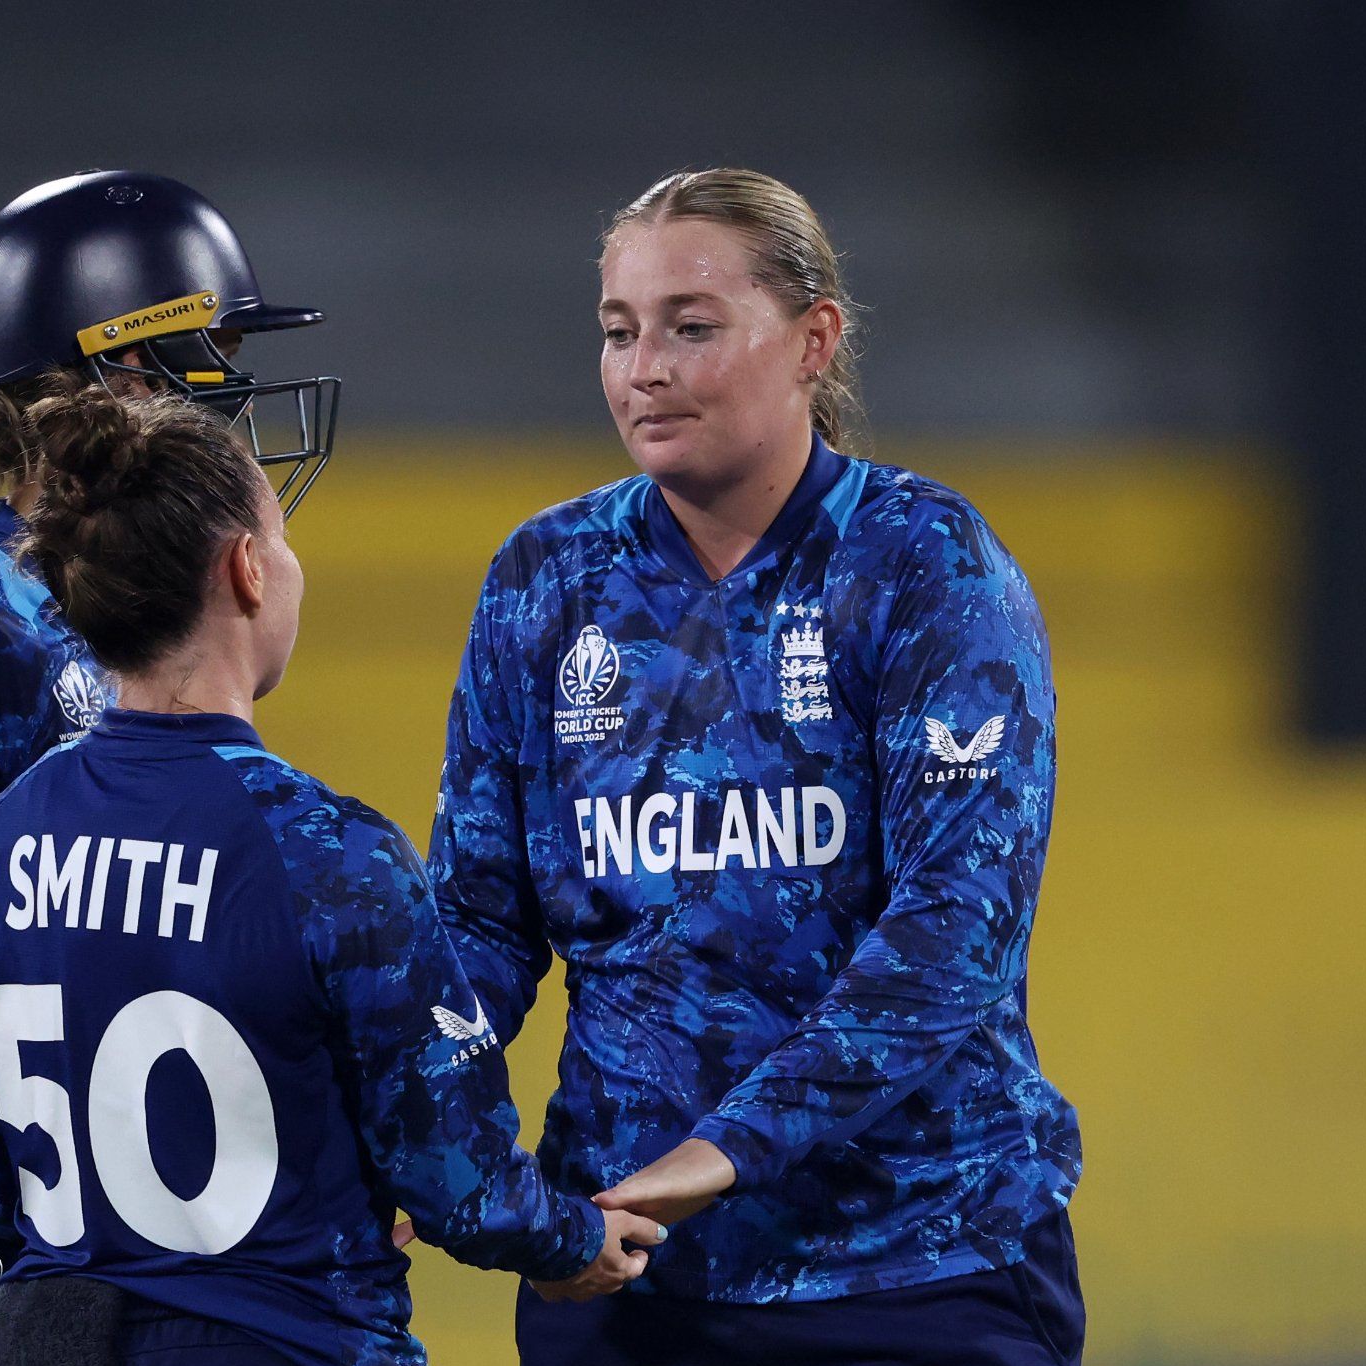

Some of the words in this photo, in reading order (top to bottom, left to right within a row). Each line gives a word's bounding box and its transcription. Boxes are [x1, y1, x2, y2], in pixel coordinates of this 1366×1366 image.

[123, 302, 195, 331] MASURI
[576, 692, 596, 706] ICC
[586, 706, 622, 717] CRICKET
[78, 714, 100, 728] ICC
[595, 717, 624, 731] CUP
[561, 735, 584, 744] INDIA
[585, 732, 606, 742] 2025
[924, 766, 999, 784] CASTORE
[574, 785, 847, 879] ENGLAND
[5, 834, 219, 943] SMITH
